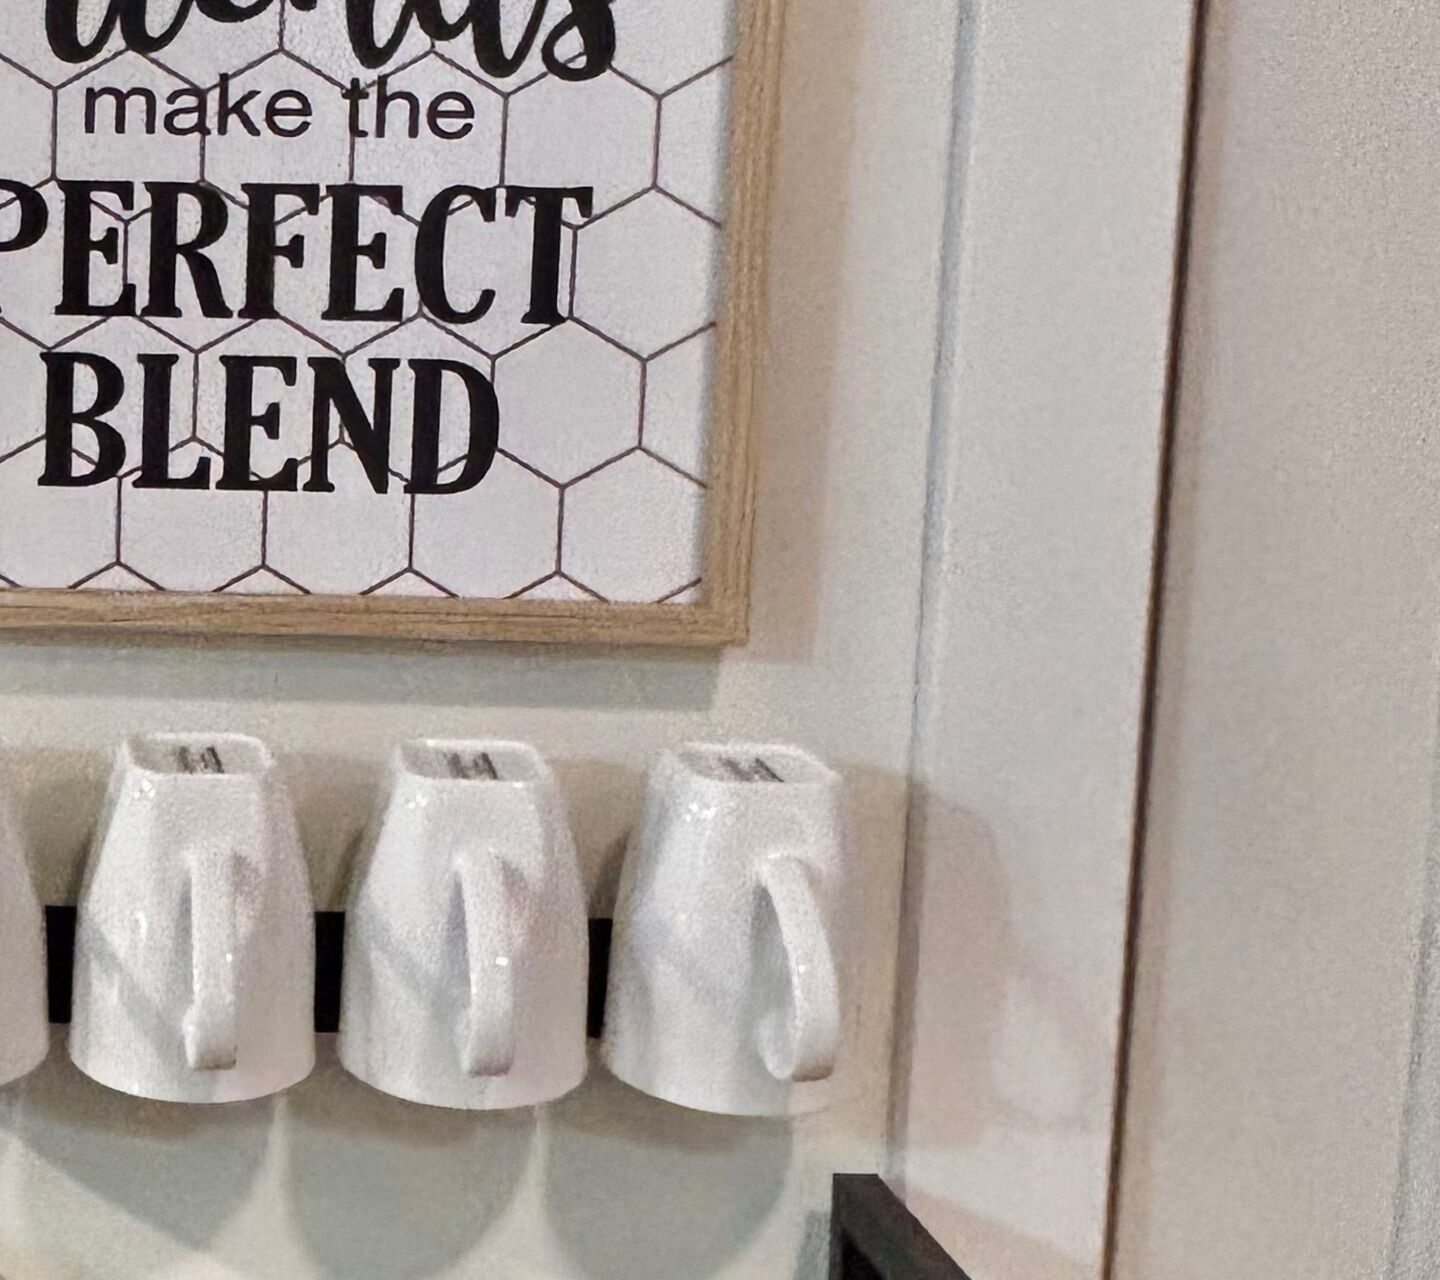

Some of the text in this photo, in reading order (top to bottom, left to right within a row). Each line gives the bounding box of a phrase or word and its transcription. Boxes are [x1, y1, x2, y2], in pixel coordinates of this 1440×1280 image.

[85, 72, 475, 139] make the
[38, 350, 500, 495] BLEND
